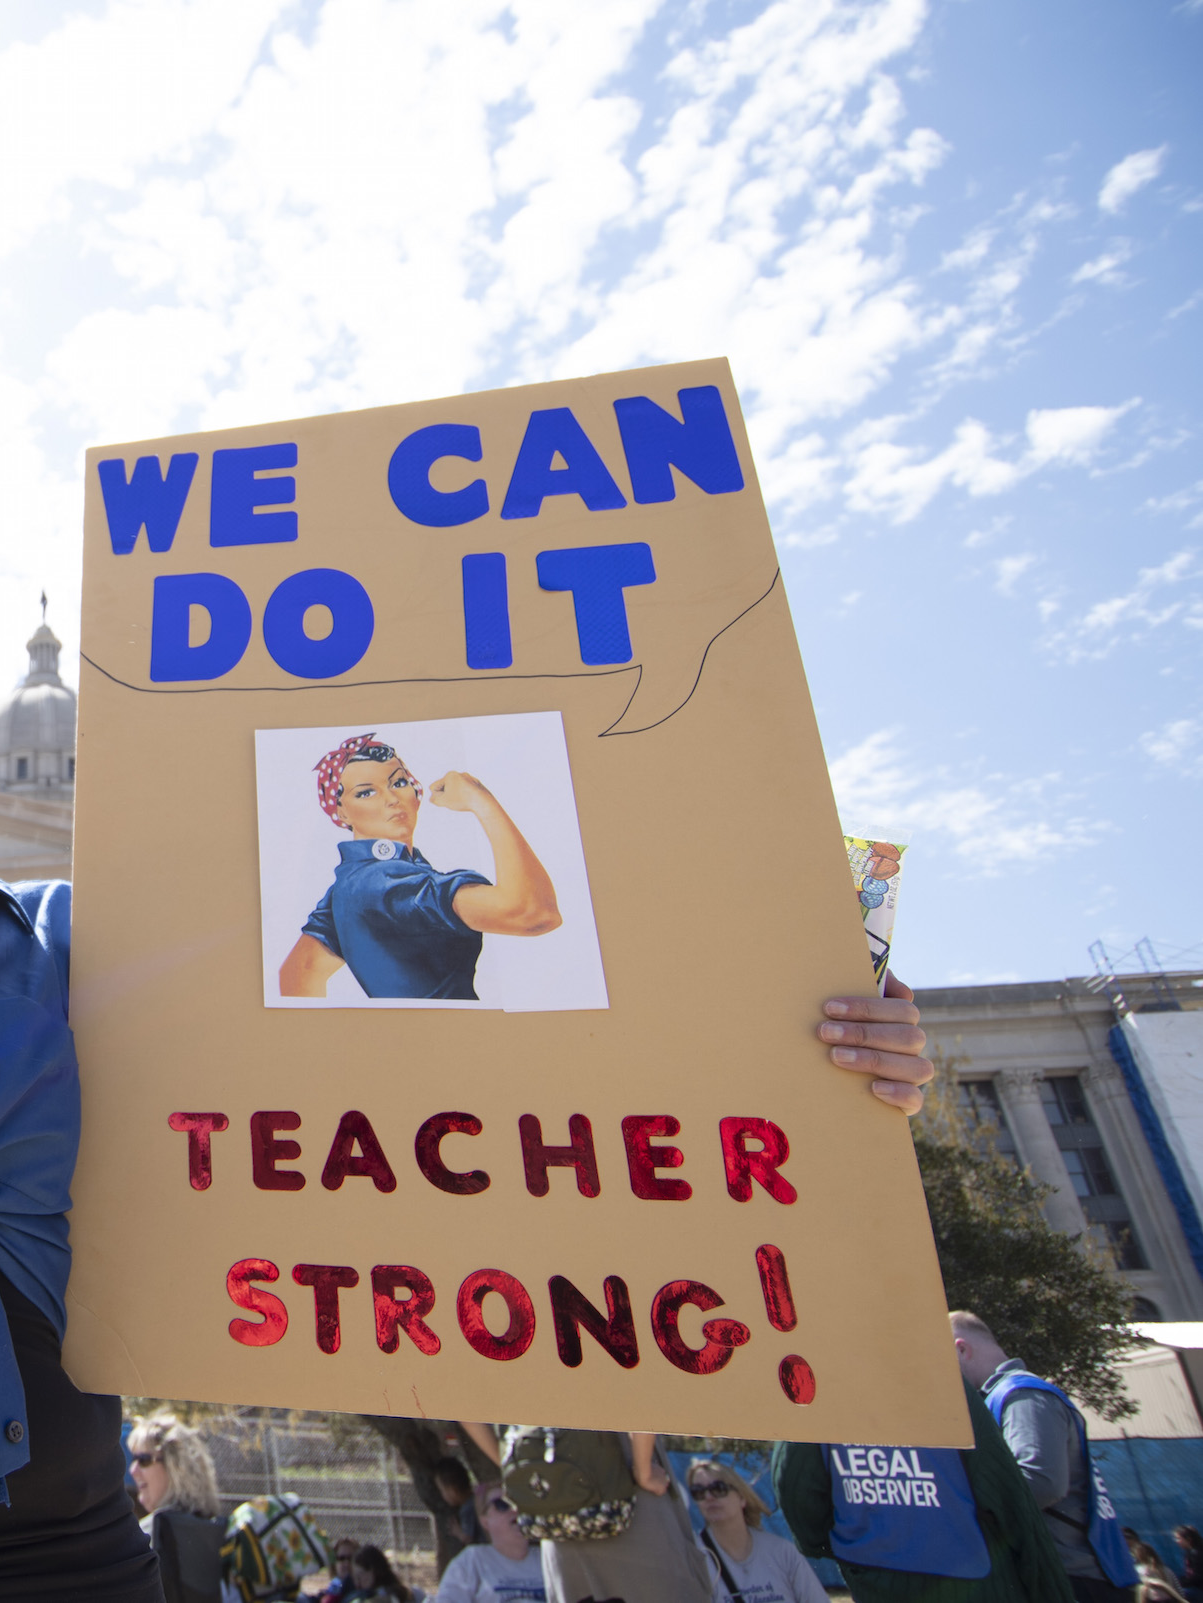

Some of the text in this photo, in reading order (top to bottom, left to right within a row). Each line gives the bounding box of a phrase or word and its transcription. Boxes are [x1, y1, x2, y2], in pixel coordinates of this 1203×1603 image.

[98, 385, 745, 555] WE CAN
[150, 542, 657, 683] DO IT
[167, 1110, 797, 1205] TEACHER
[225, 1243, 816, 1406] STRONG!
[831, 1448, 935, 1479] LEGAL
[843, 1478, 941, 1508] OBSERVER
